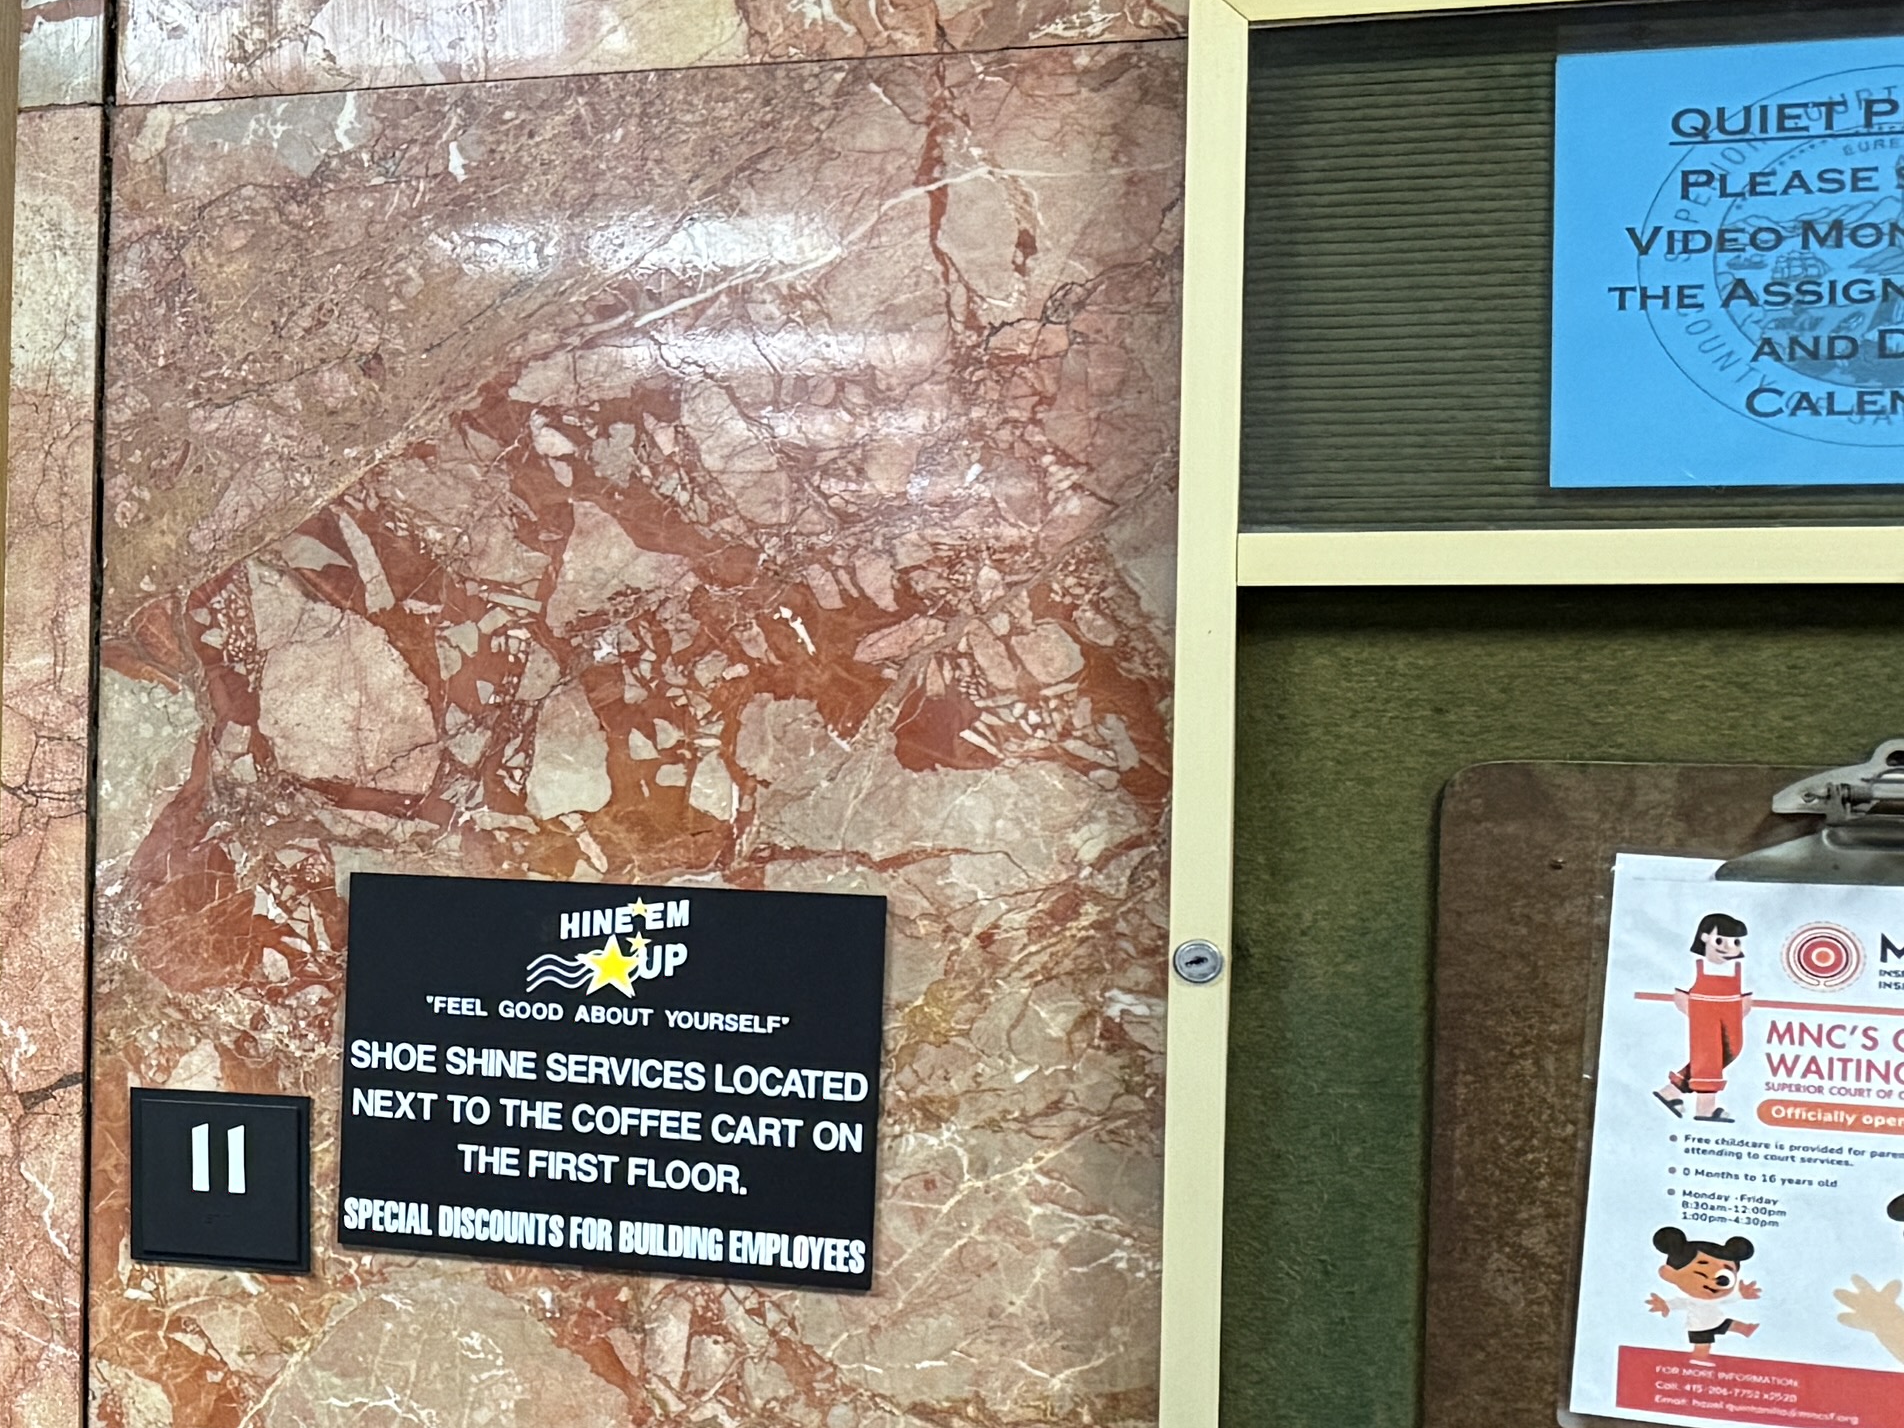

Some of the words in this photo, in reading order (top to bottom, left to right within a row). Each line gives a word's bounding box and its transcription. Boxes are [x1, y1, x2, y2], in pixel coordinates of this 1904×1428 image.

[1670, 99, 1848, 141] QUIET
[1680, 165, 1880, 201] PLEASE
[1625, 225, 1784, 257] VIDEO
[1607, 283, 1705, 312] THE
[1749, 334, 1860, 363] AND
[638, 943, 688, 980] UP
[498, 1000, 564, 1021] GOOD
[575, 1004, 654, 1027] ABOUT
[1766, 1020, 1879, 1051] MNC'S
[350, 1039, 437, 1074] SHOE
[445, 1045, 537, 1080] SHINE
[545, 1052, 707, 1092] SERVICES
[714, 1063, 869, 1103] LOCATED
[1764, 1081, 1825, 1095] SUPERIOR
[1829, 1085, 1872, 1099] COURT
[1876, 1090, 1894, 1100] OF
[352, 1087, 437, 1121] NEXT
[447, 1094, 490, 1126] TO
[499, 1097, 563, 1132] THE
[571, 1103, 703, 1141] COFFEE
[710, 1113, 804, 1149] CART
[812, 1121, 863, 1154] ON
[1771, 1106, 1857, 1127] Officially
[192, 1123, 246, 1194] 11
[1684, 1134, 1711, 1144] Free
[1715, 1138, 1771, 1150] childcare
[1775, 1141, 1785, 1150] is
[1789, 1144, 1843, 1155] provided
[1848, 1147, 1865, 1156] for
[1684, 1147, 1742, 1160] attending
[1747, 1151, 1759, 1160] to
[1764, 1153, 1796, 1163] court
[1799, 1156, 1854, 1167] services.
[457, 1143, 521, 1178] THE
[528, 1149, 620, 1185] FIRST
[627, 1157, 748, 1197] FLOOR.
[1695, 1168, 1739, 1180] Months
[1744, 1173, 1757, 1182] to
[1761, 1174, 1776, 1183] 16
[1780, 1177, 1813, 1186] years
[1818, 1179, 1838, 1188] old
[1683, 1189, 1730, 1202] Monday
[343, 1195, 433, 1237] SPECIAL
[438, 1204, 564, 1249] DISCOUNTS
[570, 1215, 612, 1251] FOR
[619, 1219, 724, 1264] BUILDING
[728, 1228, 867, 1275] EMPLOYEES
[1656, 1365, 1680, 1375] FOR
[1682, 1368, 1715, 1379] MORE
[1718, 1371, 1799, 1388] INFORMATION
